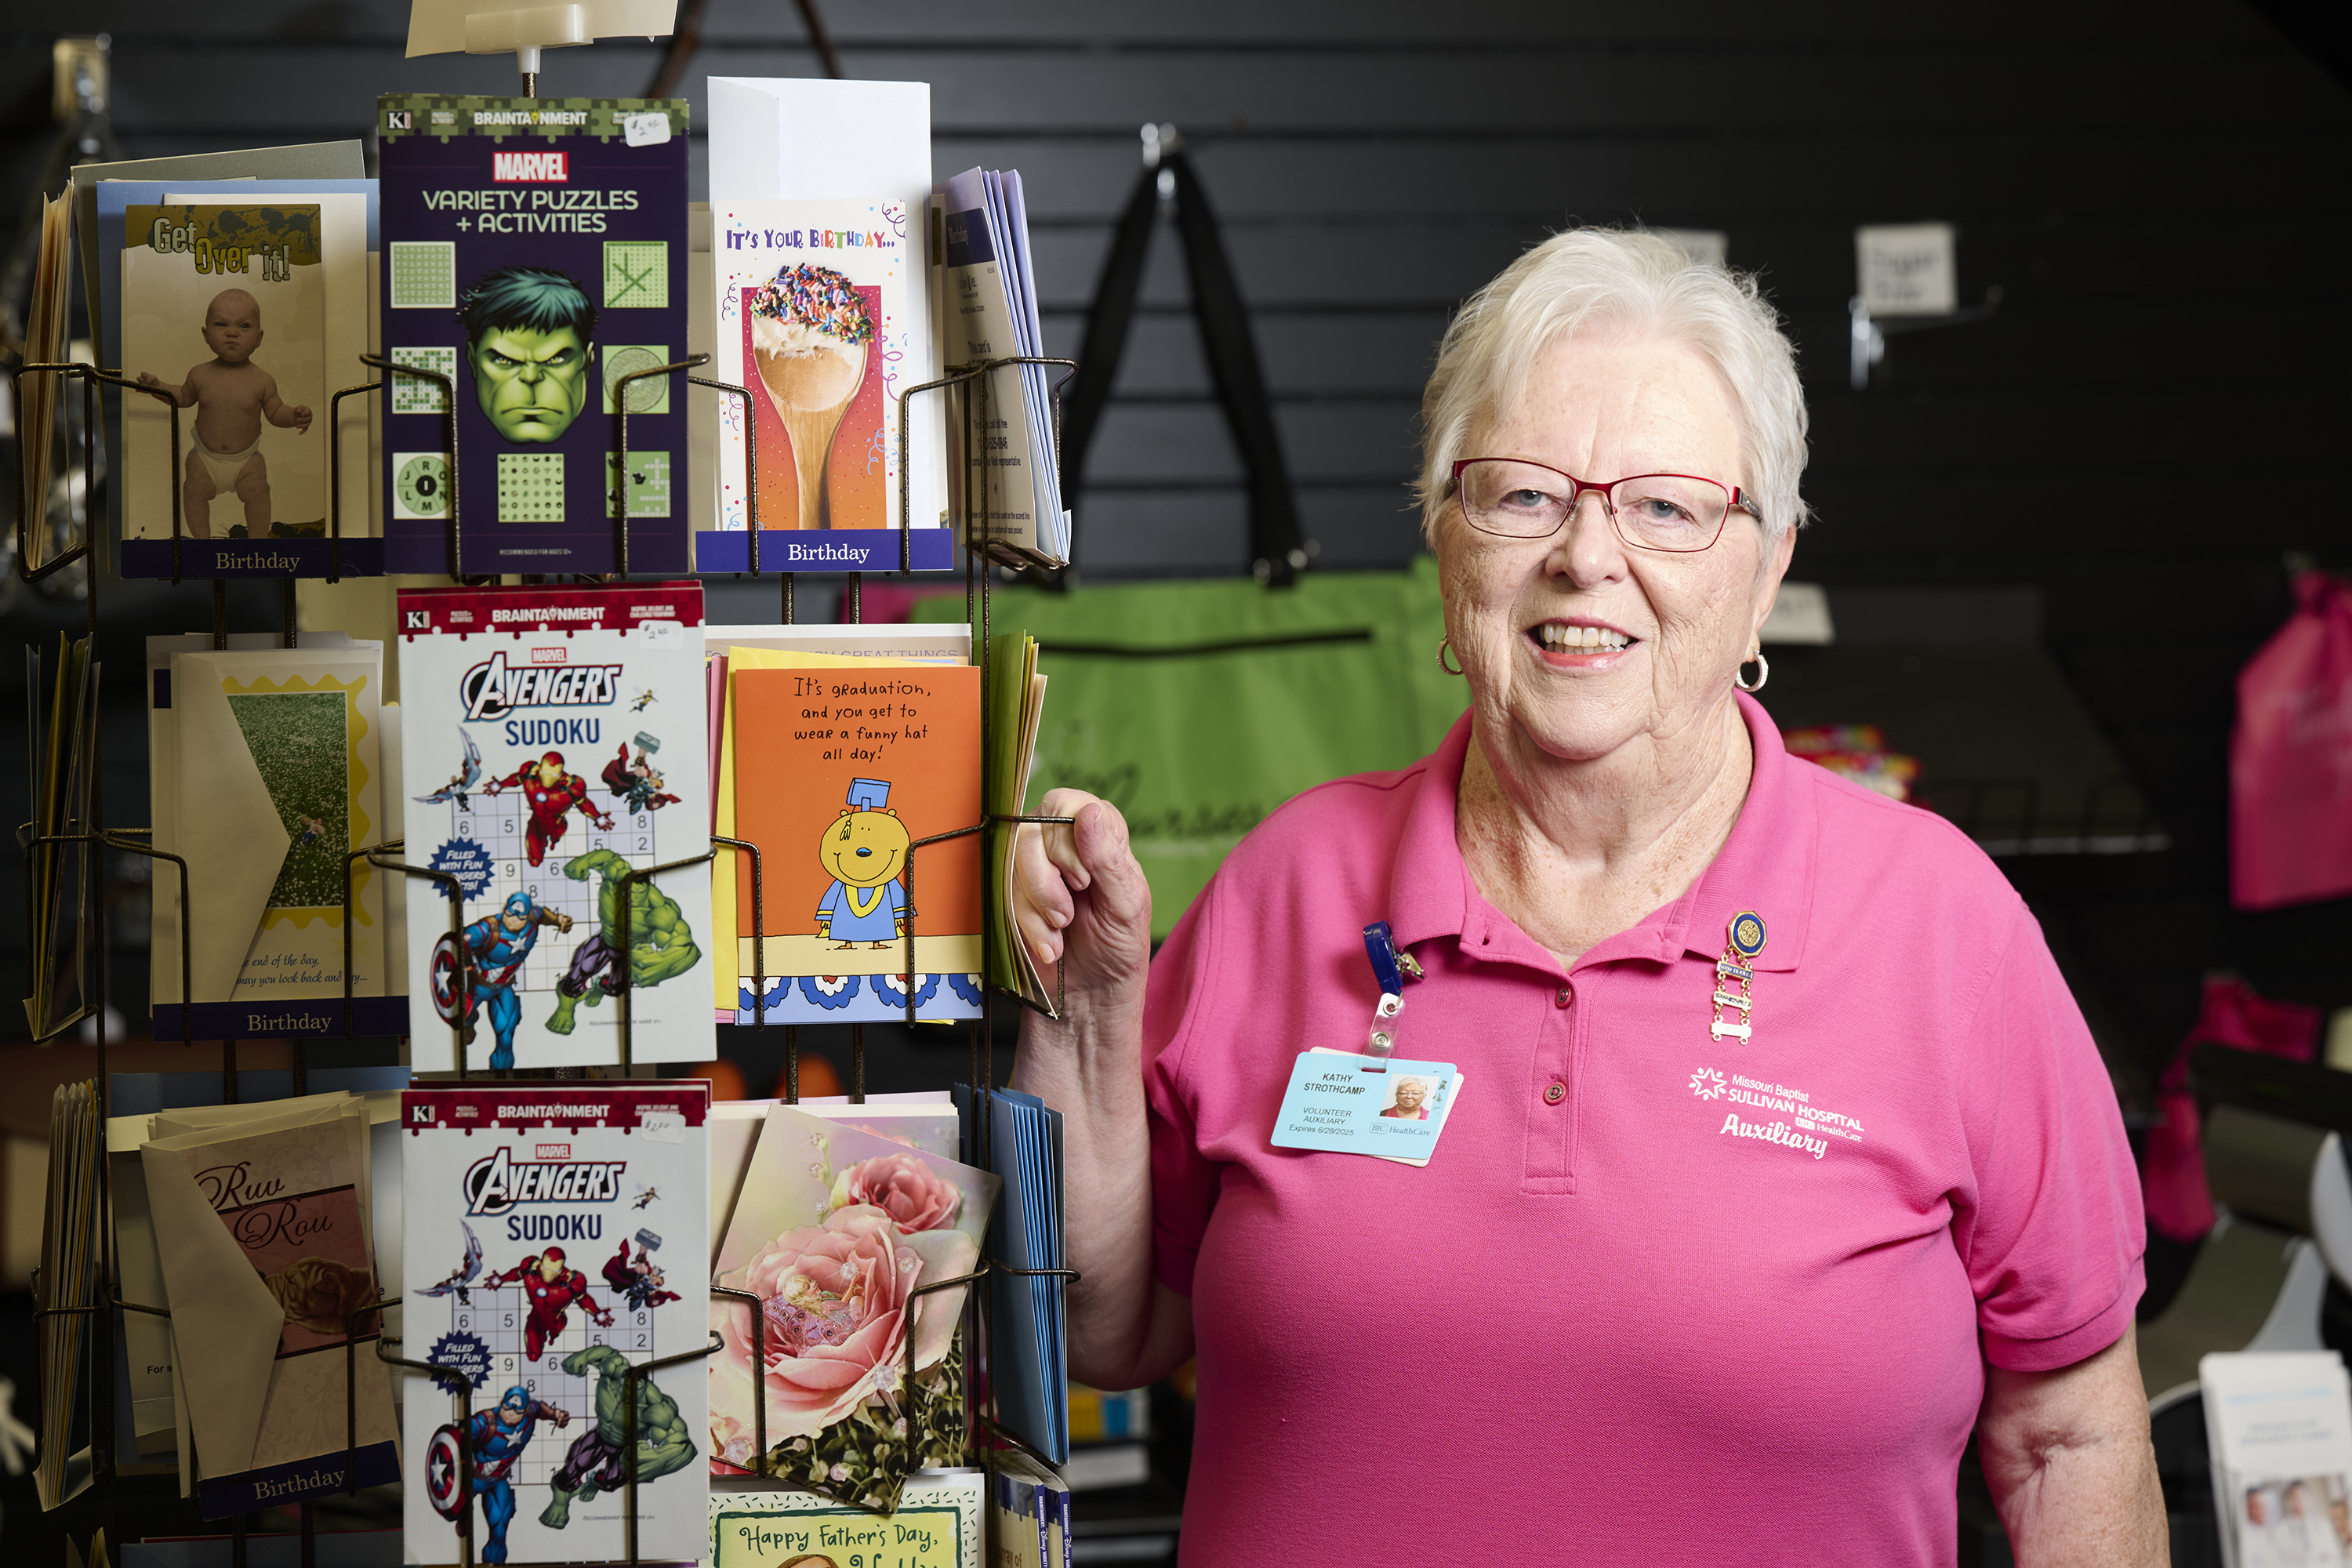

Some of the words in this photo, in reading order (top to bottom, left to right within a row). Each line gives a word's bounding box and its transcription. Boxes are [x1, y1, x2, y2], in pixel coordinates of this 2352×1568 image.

[494, 153, 568, 180] MARVEL
[422, 190, 526, 210] VARIETY
[532, 190, 639, 210] PUZZLES
[456, 216, 472, 232] +
[477, 212, 607, 233] ACTIVITIES
[153, 217, 197, 253] Get
[194, 237, 251, 274] Over
[262, 244, 291, 282] it!
[423, 462, 430, 470] R
[215, 552, 300, 572] Birthday
[788, 544, 870, 564] Birthday
[532, 648, 566, 662] MARVEL
[463, 652, 623, 722] AVENGERS
[793, 677, 822, 698] It's
[801, 706, 828, 719] and
[834, 706, 862, 720] you
[869, 704, 893, 720] get
[900, 704, 916, 717] to
[506, 718, 600, 746] SUDOKU
[840, 730, 850, 739] a
[856, 727, 898, 744] funny
[905, 724, 928, 739] hat
[822, 748, 843, 760] all
[850, 745, 884, 763] day!
[460, 821, 469, 834] 6
[505, 820, 514, 833] 5
[638, 815, 647, 829] 8
[638, 837, 648, 851] 2
[445, 850, 476, 860] FILLED
[463, 860, 484, 869] FUN
[506, 864, 514, 877] 9
[550, 862, 559, 875] 6
[529, 885, 538, 898] 8
[252, 955, 269, 966] end
[271, 953, 281, 968] of
[284, 953, 297, 967] the
[300, 953, 319, 968] day,
[259, 977, 275, 988] you
[278, 971, 299, 984] look
[300, 971, 322, 983] back
[325, 971, 342, 982] and
[247, 1013, 332, 1033] Birthday
[1323, 1073, 1353, 1083] KATHY
[1304, 1083, 1366, 1094] STROTHCAMP
[1732, 1074, 1774, 1094] Missouri
[1775, 1084, 1809, 1102] Baptist
[1303, 1107, 1352, 1117] VOLUNTEER
[1728, 1088, 1795, 1112] SULLIVAN
[1798, 1104, 1864, 1131] HOSPITAL
[1303, 1116, 1346, 1125] AUXILIARY
[1289, 1124, 1316, 1133] Expires
[1317, 1127, 1355, 1136] 6/28/2025
[1371, 1124, 1387, 1134] BJC
[1389, 1126, 1431, 1136] HealthCare
[1720, 1113, 1828, 1160] Auxiliary
[1817, 1123, 1862, 1142] HealthCare
[537, 1145, 570, 1159] MARVEL
[466, 1146, 626, 1216] AVENGERS
[507, 1214, 602, 1241] SUDOKU
[459, 1315, 468, 1327] 6
[504, 1314, 514, 1327] 5
[637, 1312, 646, 1325] 8
[445, 1343, 475, 1352] FILLED
[637, 1334, 646, 1347] 2
[461, 1353, 482, 1363] FUN
[504, 1358, 513, 1370] 9
[549, 1357, 557, 1370] 6
[147, 1365, 164, 1374] For
[527, 1380, 535, 1392] 8
[253, 1469, 346, 1501] Birthday
[739, 1526, 809, 1555] Happy
[819, 1523, 886, 1548] Father's
[893, 1524, 938, 1552] Day,
